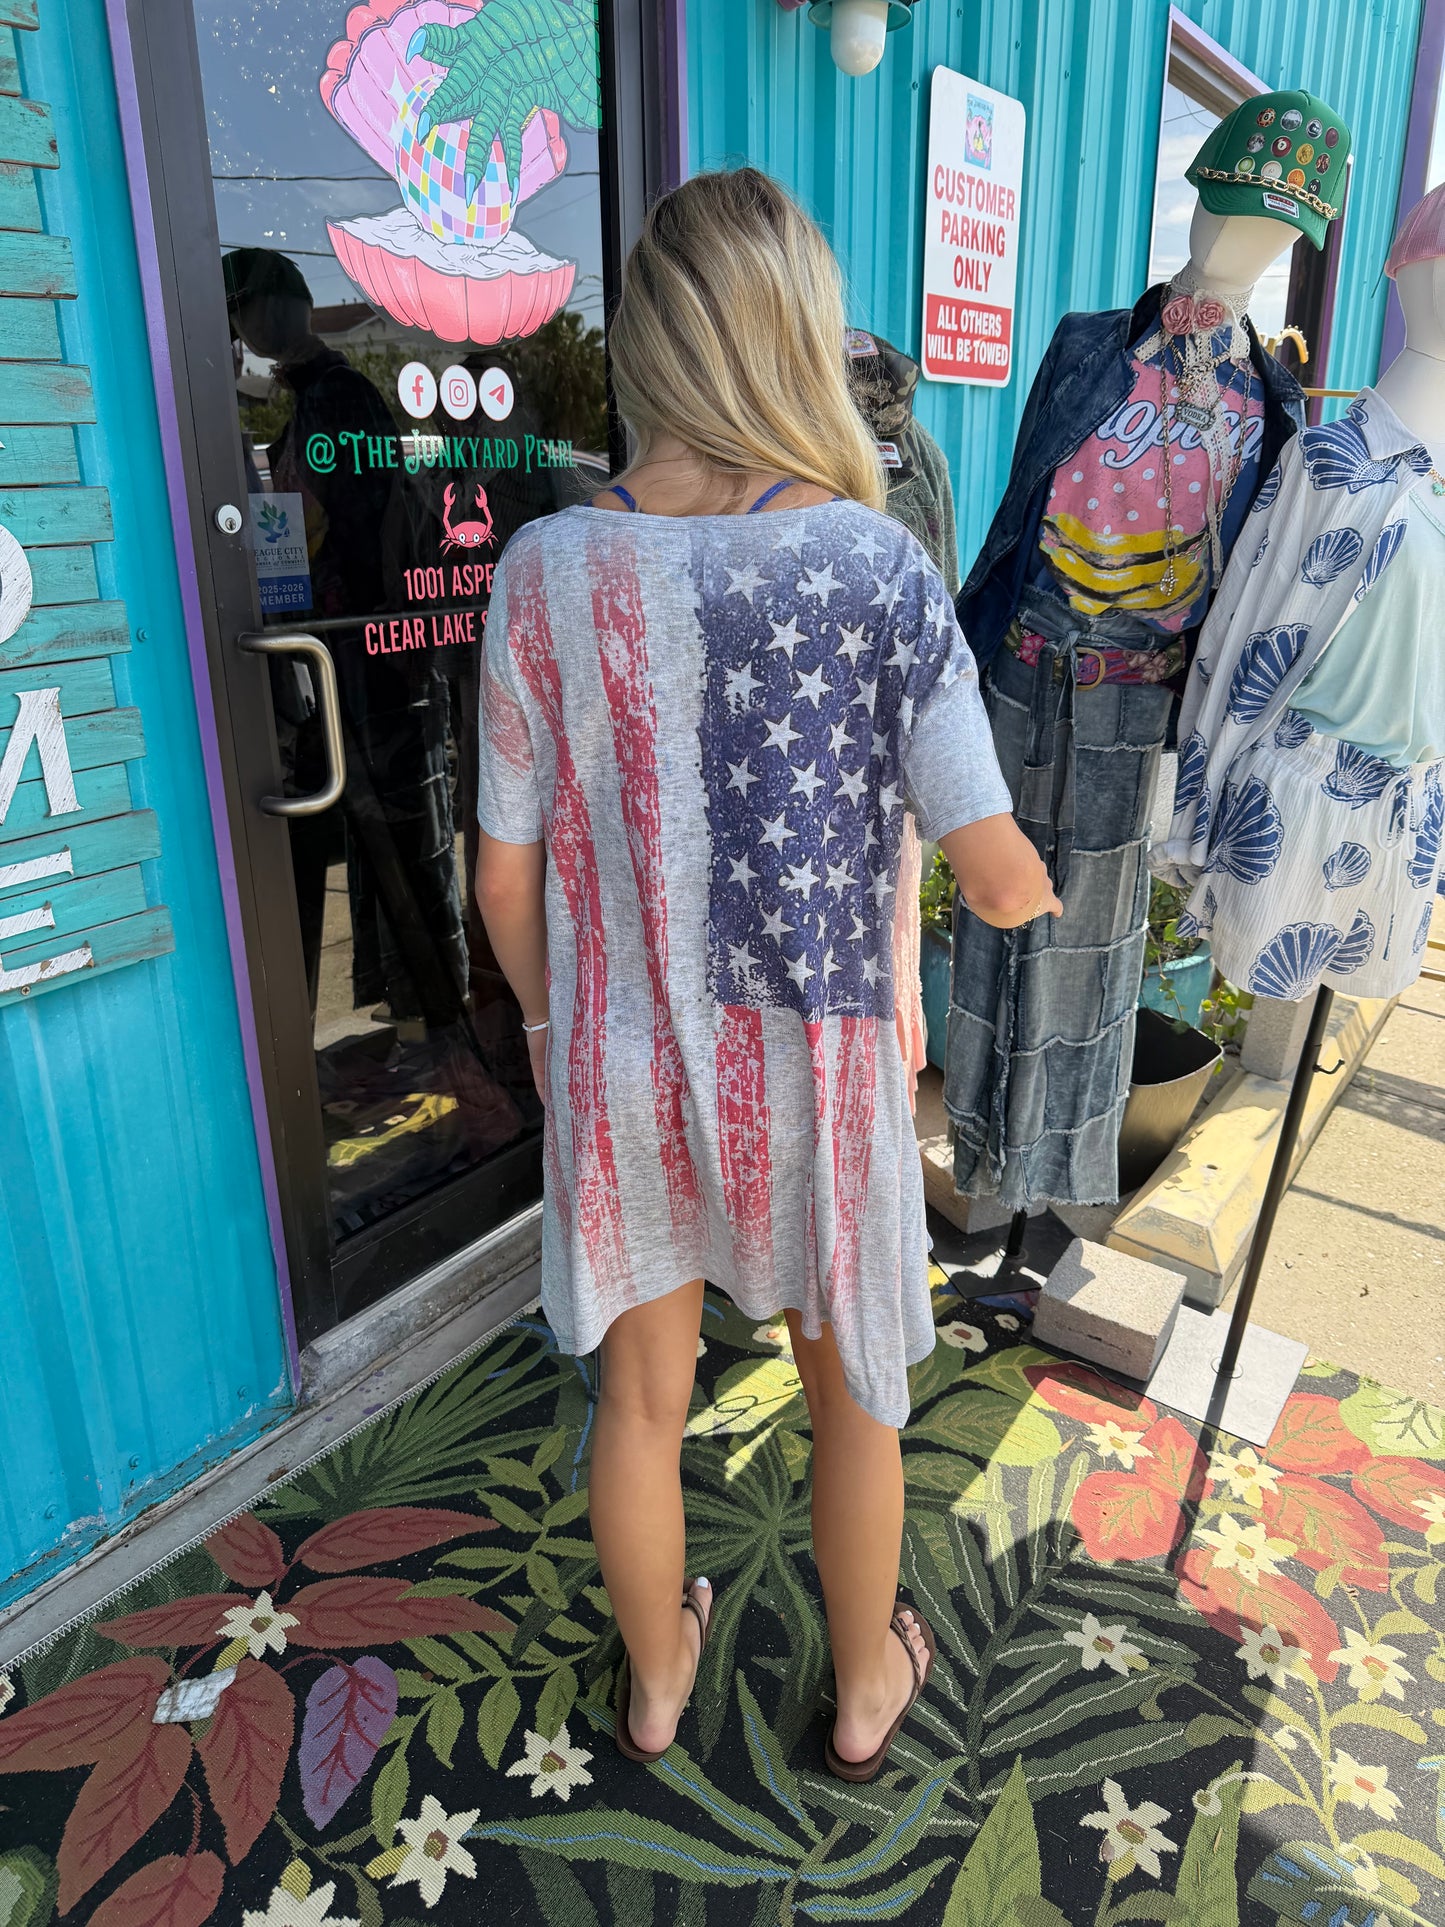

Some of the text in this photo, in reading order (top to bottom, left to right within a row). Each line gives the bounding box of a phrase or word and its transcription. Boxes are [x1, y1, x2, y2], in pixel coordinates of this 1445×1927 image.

[934, 164, 1015, 221] CUSTOMER
[941, 209, 1005, 258] PARKING
[953, 254, 992, 293] ONLY
[937, 304, 1002, 338] ALL OTHERS
[927, 333, 1008, 367] WILL BE TOWED
[1182, 407, 1208, 424] VODKA
[255, 547, 304, 557] EAGUE CITY
[404, 563, 498, 600] 1001 ASPE
[261, 594, 305, 606] MEMBER
[365, 618, 426, 655] CLEAR
[432, 612, 476, 647] LAKE
